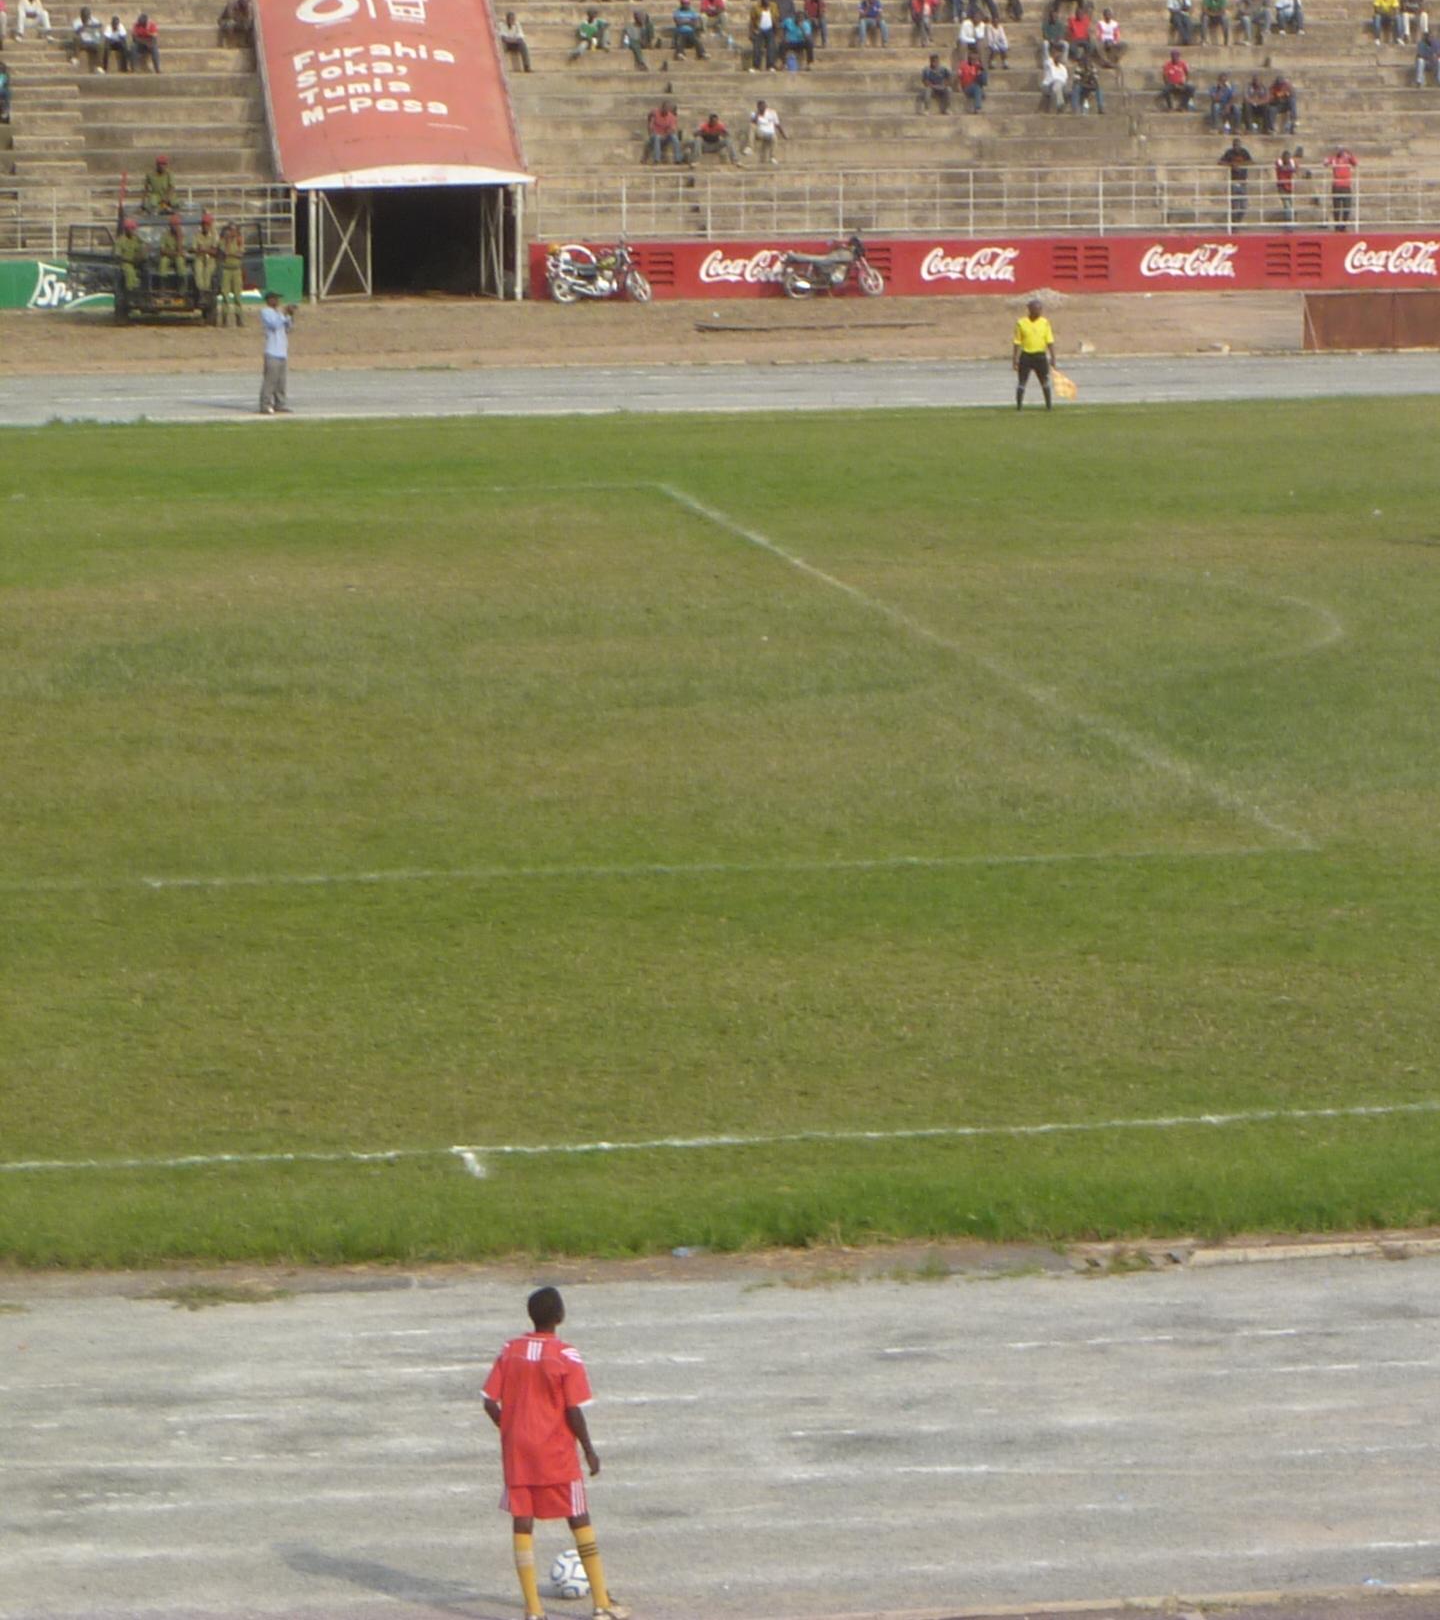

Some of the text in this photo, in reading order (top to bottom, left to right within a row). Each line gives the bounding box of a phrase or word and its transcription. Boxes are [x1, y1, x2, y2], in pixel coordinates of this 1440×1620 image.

[293, 41, 455, 71] Furahia
[296, 60, 407, 88] Soka,
[299, 77, 411, 105] Tumia
[301, 96, 448, 127] M-Pesa
[920, 247, 1019, 281] Coca-Cola
[1140, 244, 1238, 277] Coca-Cola
[1344, 241, 1440, 275] Coca-Cola
